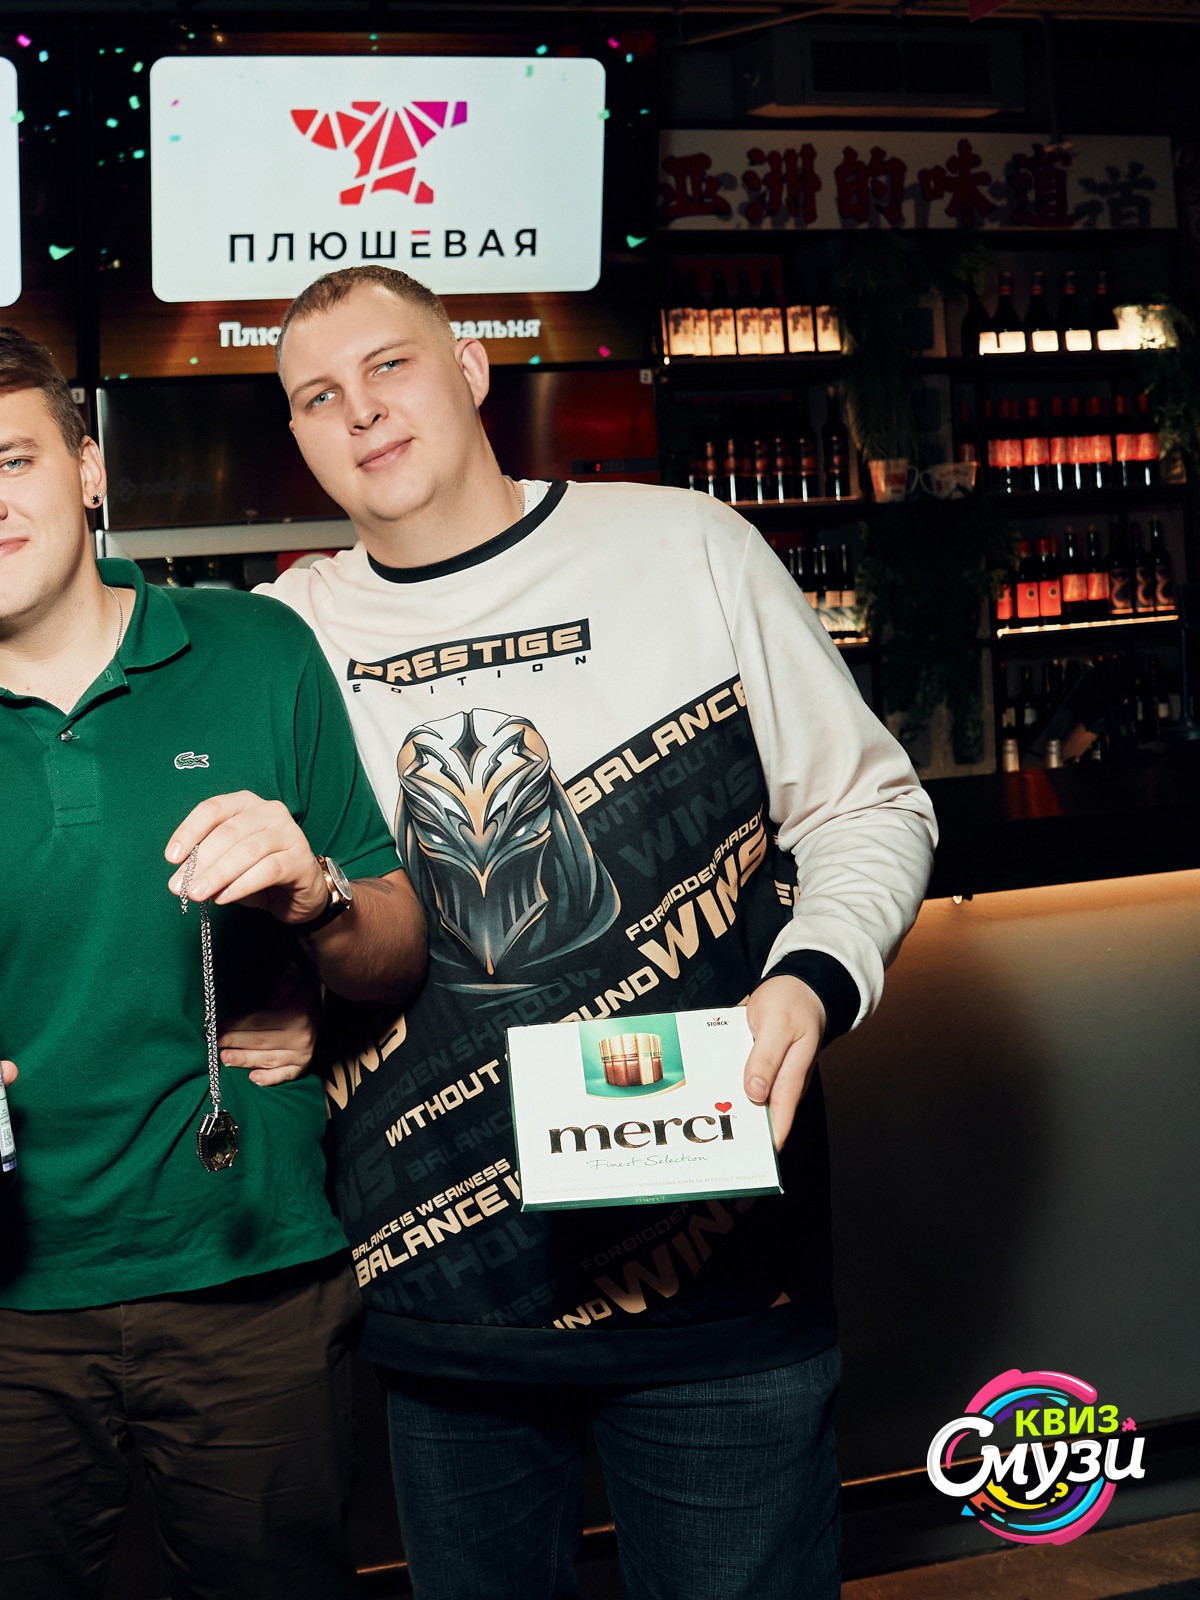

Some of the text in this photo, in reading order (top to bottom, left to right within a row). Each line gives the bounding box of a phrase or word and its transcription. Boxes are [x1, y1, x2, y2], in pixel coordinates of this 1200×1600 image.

[660, 138, 1084, 228] 亚洲的味道
[229, 229, 539, 263] ПЛЮШЕВАЯ
[352, 655, 588, 694] EDITION
[353, 625, 584, 683] PRESTIGE
[624, 857, 718, 942] FORBIDDEN
[385, 1058, 501, 1148] WITHOUT
[636, 820, 768, 980] WINS
[548, 1101, 734, 1154] merci
[585, 1154, 709, 1171] Finest Selection
[351, 1219, 402, 1262] BALANCE
[416, 1158, 511, 1217] WEAKNESS
[354, 1184, 510, 1288] BALANCE
